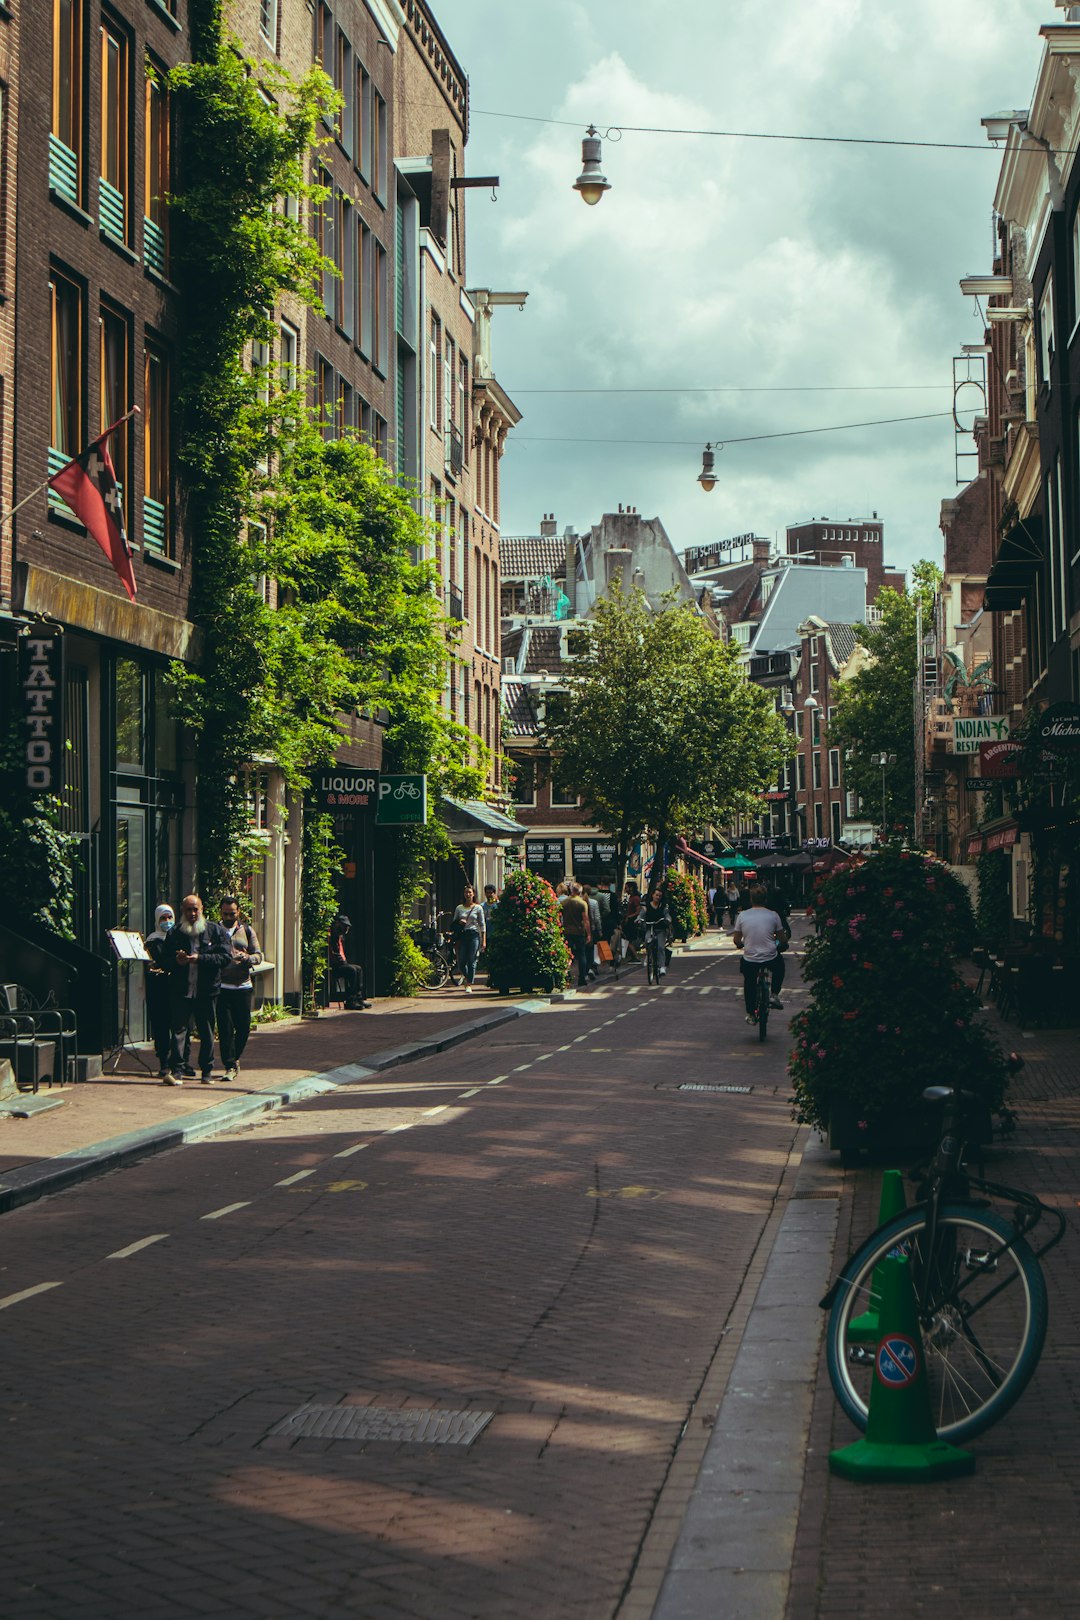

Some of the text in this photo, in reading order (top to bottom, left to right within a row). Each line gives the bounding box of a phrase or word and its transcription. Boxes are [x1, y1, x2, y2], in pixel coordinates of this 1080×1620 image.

[699, 540, 732, 558] SCHILLER
[732, 532, 754, 549] HOTEL
[23, 639, 56, 789] TATTOO
[955, 720, 990, 738] INDIAN
[957, 741, 981, 752] RESTA
[322, 777, 376, 793] LIQUOR
[379, 782, 392, 800] P
[327, 793, 369, 806] & MORE
[748, 838, 777, 850] PRIME
